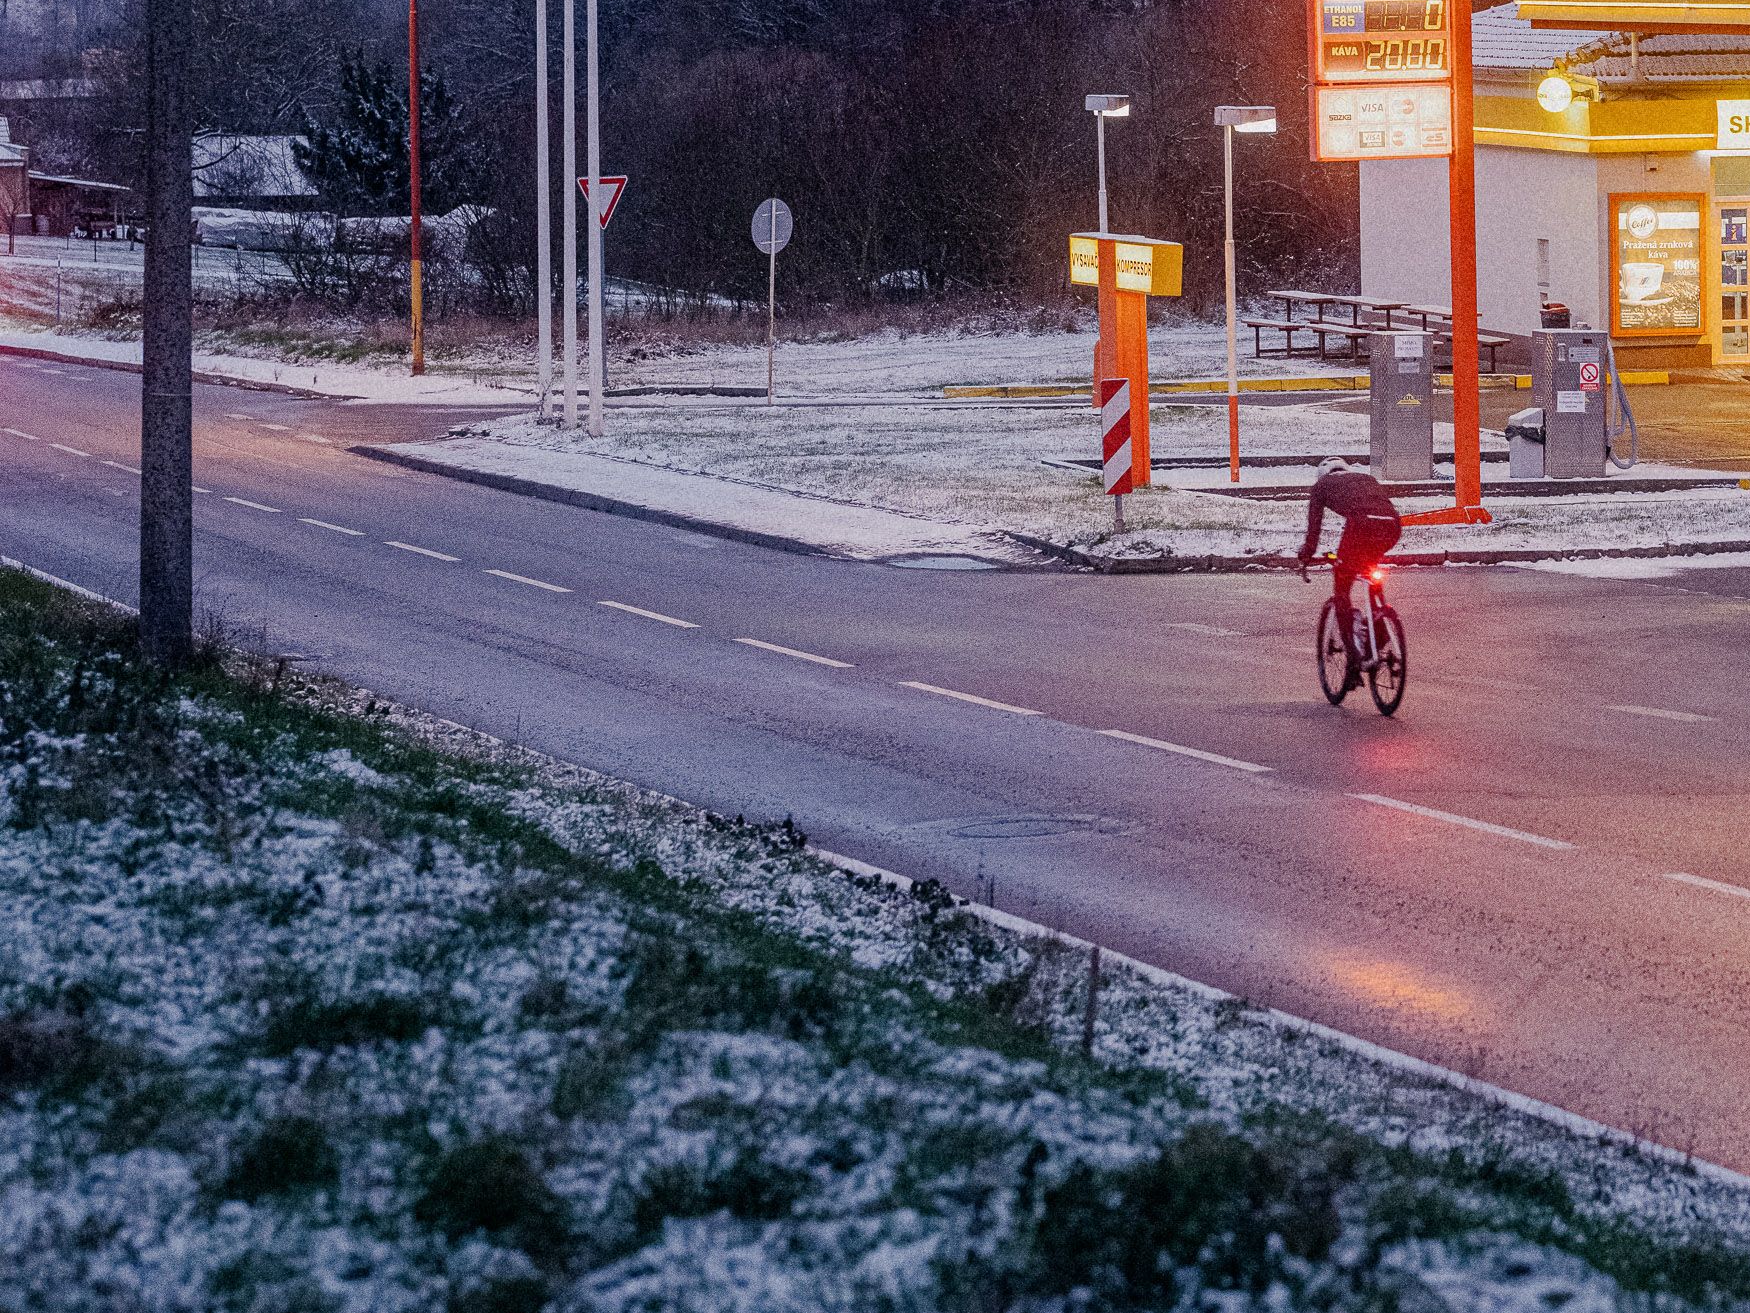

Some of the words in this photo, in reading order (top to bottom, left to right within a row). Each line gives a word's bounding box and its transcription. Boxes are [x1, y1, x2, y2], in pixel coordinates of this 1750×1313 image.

[1324, 5, 1363, 14] ETHANOL
[1332, 16, 1355, 27] E85
[1332, 44, 1358, 56] KÁVA
[1362, 104, 1384, 112] VISA
[1623, 239, 1657, 249] Pražená
[1660, 239, 1693, 249] zrnková
[1648, 250, 1668, 259] káva
[1117, 259, 1151, 276] KOMPRESOR
[1673, 260, 1697, 270] 100%
